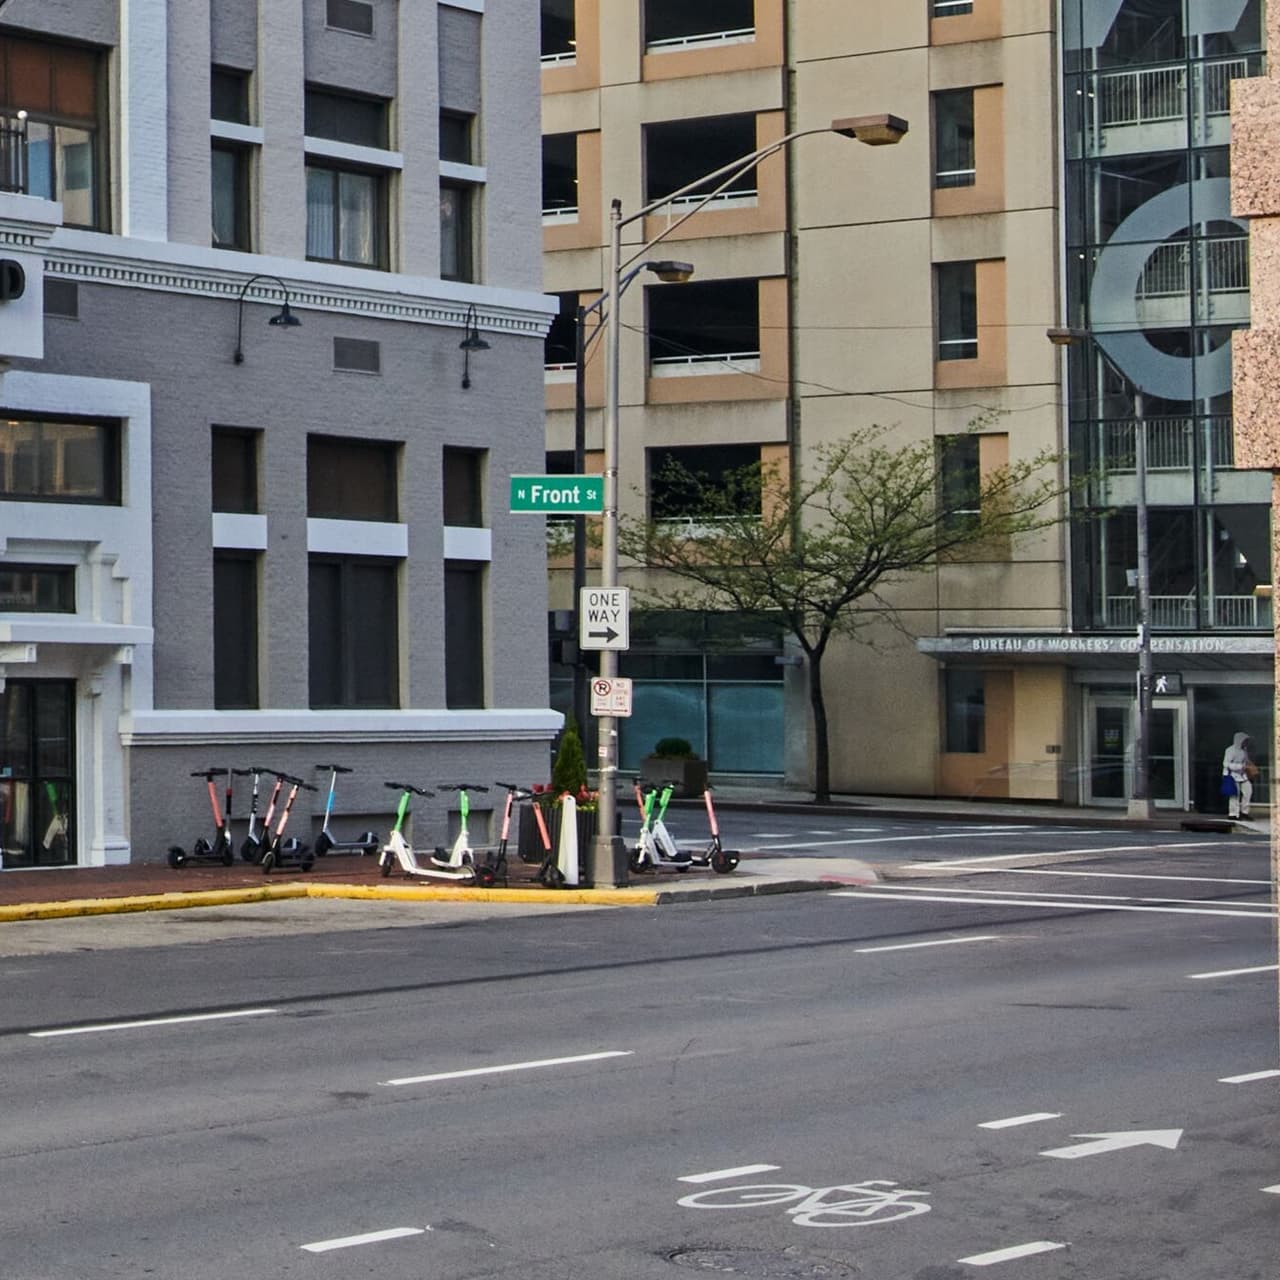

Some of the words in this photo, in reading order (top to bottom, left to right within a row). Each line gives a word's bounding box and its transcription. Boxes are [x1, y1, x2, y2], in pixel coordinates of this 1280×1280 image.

[518, 489, 525, 499] N
[530, 485, 580, 504] Front
[586, 489, 596, 500] St
[589, 593, 620, 607] ONE
[588, 610, 620, 623] WAY
[972, 639, 1021, 650] BUREAU
[1027, 639, 1042, 650] OF
[1120, 639, 1225, 651] COPENSATION
